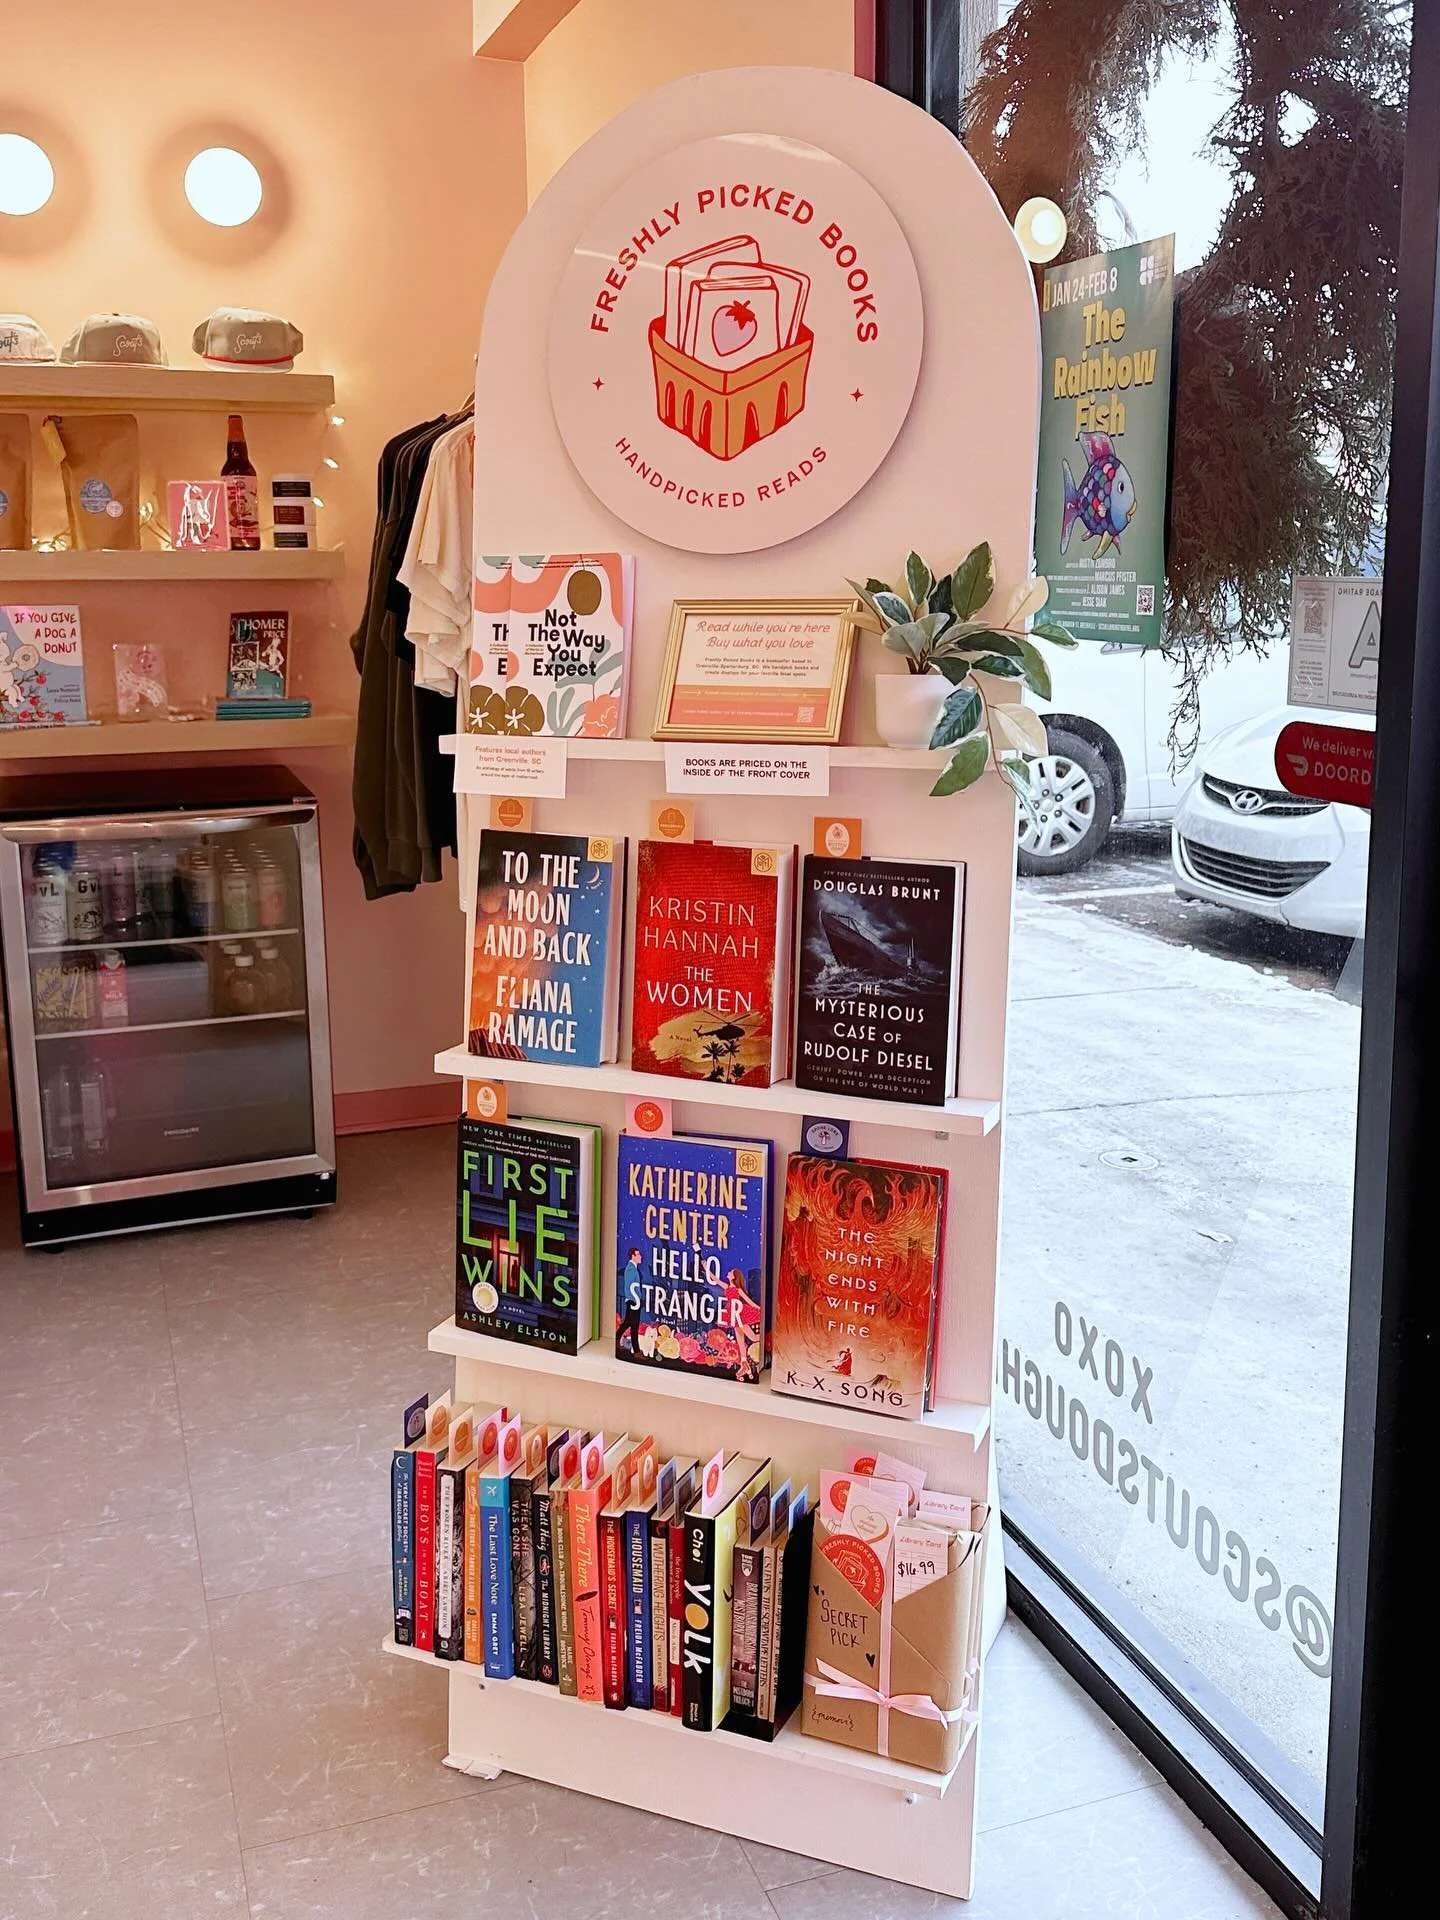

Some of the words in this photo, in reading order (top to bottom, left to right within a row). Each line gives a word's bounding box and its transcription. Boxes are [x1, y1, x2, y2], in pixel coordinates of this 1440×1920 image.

[590, 201, 681, 333] FRESHLY
[697, 184, 814, 225] PICKED
[819, 222, 879, 343] BOOKS
[1052, 280, 1071, 308] JAN
[1110, 266, 1118, 292] 8
[1083, 301, 1126, 349] The
[1054, 348, 1158, 400] Rainbow
[1075, 393, 1126, 441] Fish
[615, 437, 745, 508] HANDPICKED
[757, 446, 827, 501] READS
[14, 612, 25, 624] IF
[28, 612, 48, 624] YOU
[50, 612, 77, 624] GIVE
[244, 618, 286, 631] HOMER
[544, 609, 577, 627] Not
[696, 620, 731, 633] Read
[732, 621, 765, 634] while
[765, 621, 802, 635] you're
[803, 622, 831, 633] here
[34, 628, 41, 640] A
[44, 627, 67, 639] DOG
[70, 627, 77, 637] A
[44, 642, 77, 654] DONUT
[263, 630, 286, 639] PRICE
[528, 623, 560, 642] The
[563, 629, 605, 653] Way
[706, 636, 731, 649] Buy
[732, 637, 764, 648] what
[764, 638, 788, 650] you
[789, 637, 814, 648] love
[547, 643, 581, 662] You
[533, 658, 597, 682] Expect
[1302, 736, 1320, 750] We
[1322, 737, 1360, 757] deliver
[683, 768, 711, 777] INSIDE
[713, 769, 726, 777] OF
[728, 769, 745, 777] THE
[748, 770, 778, 778] FRONT
[779, 771, 810, 779] COVER
[685, 758, 716, 767] BOOKS
[718, 759, 736, 767] ARE
[739, 759, 772, 768] PRICED
[774, 760, 788, 769] ON
[790, 761, 808, 769] THE
[1313, 761, 1372, 786] DOORD
[502, 850, 529, 885] TO
[539, 853, 581, 889] THE
[813, 879, 883, 896] DOUGLAS
[891, 885, 941, 901] BRUNT
[507, 888, 572, 927] MOON
[649, 895, 756, 927] KRISTIN
[483, 924, 527, 960] AND
[531, 928, 592, 967] BACK
[644, 926, 759, 960] HANNAH
[683, 965, 714, 984] THE
[857, 983, 881, 996] THE
[495, 975, 573, 1016] ELIANA
[646, 979, 752, 1014] WOMEN
[815, 998, 925, 1024] MYSTERIOUS
[487, 1011, 578, 1054] RAMAGE
[833, 1022, 877, 1042] CASE
[883, 1031, 902, 1044] OF
[804, 1041, 870, 1064] RUDOLF
[877, 1050, 934, 1072] DIESEL
[463, 1125, 479, 1133] NEW
[482, 1128, 504, 1137] YORK
[508, 1133, 532, 1143] TIMES
[463, 1149, 574, 1201] FIRST
[628, 1162, 749, 1211] KATHERINE
[462, 1188, 569, 1266] LIE
[644, 1203, 729, 1250] CENTER
[838, 1226, 877, 1245] THE
[652, 1246, 722, 1287] HELLO
[825, 1249, 885, 1271] NIGHT
[461, 1253, 571, 1308] WINS
[827, 1272, 878, 1293] ENDS
[629, 1281, 744, 1328] STRANGER
[826, 1295, 876, 1317] WITH
[463, 1311, 511, 1329] ASHLEY
[517, 1320, 568, 1344] ELSTON
[827, 1319, 872, 1339] FIRE
[786, 1370, 805, 1388] K.
[811, 1375, 832, 1394] X.
[840, 1381, 904, 1408] SONG
[512, 1500, 520, 1523] WAS
[520, 1501, 529, 1531] THEN
[540, 1500, 550, 1526] Matt
[925, 1501, 948, 1511] Library
[948, 1505, 966, 1513] Card
[419, 1504, 429, 1545] BOYS
[488, 1514, 498, 1533] The
[575, 1504, 590, 1545] There
[607, 1520, 615, 1533] THE
[489, 1535, 498, 1558] Last
[512, 1529, 520, 1558] GONE
[521, 1536, 530, 1558] SHE
[537, 1528, 551, 1551] Haig
[692, 1528, 704, 1564] Choi
[900, 1536, 924, 1547] Library
[924, 1540, 942, 1549] Card
[489, 1559, 498, 1581] Love
[577, 1547, 593, 1588] There
[606, 1535, 616, 1582] HOUSEMAID'S
[631, 1537, 644, 1594] HOUSEMAID
[653, 1543, 664, 1599] WUTHERING
[822, 1539, 850, 1553] FRESHLY
[852, 1540, 876, 1562] PICKED
[873, 1564, 882, 1594] BOOKS
[897, 1560, 936, 1578] $16.99
[419, 1580, 429, 1621] BOAT
[490, 1582, 499, 1605] Note
[608, 1583, 617, 1610] SECRET
[542, 1591, 550, 1628] MIDNIGHT
[654, 1599, 665, 1641] HEIGHTS
[820, 1599, 869, 1635] SECRET
[578, 1605, 595, 1646] Tommy
[635, 1619, 643, 1644] FREIDA
[830, 1628, 860, 1648] PICK
[543, 1629, 551, 1660] LIBRARY
[580, 1646, 596, 1679] Orange
[635, 1646, 643, 1683] McFADDEN
